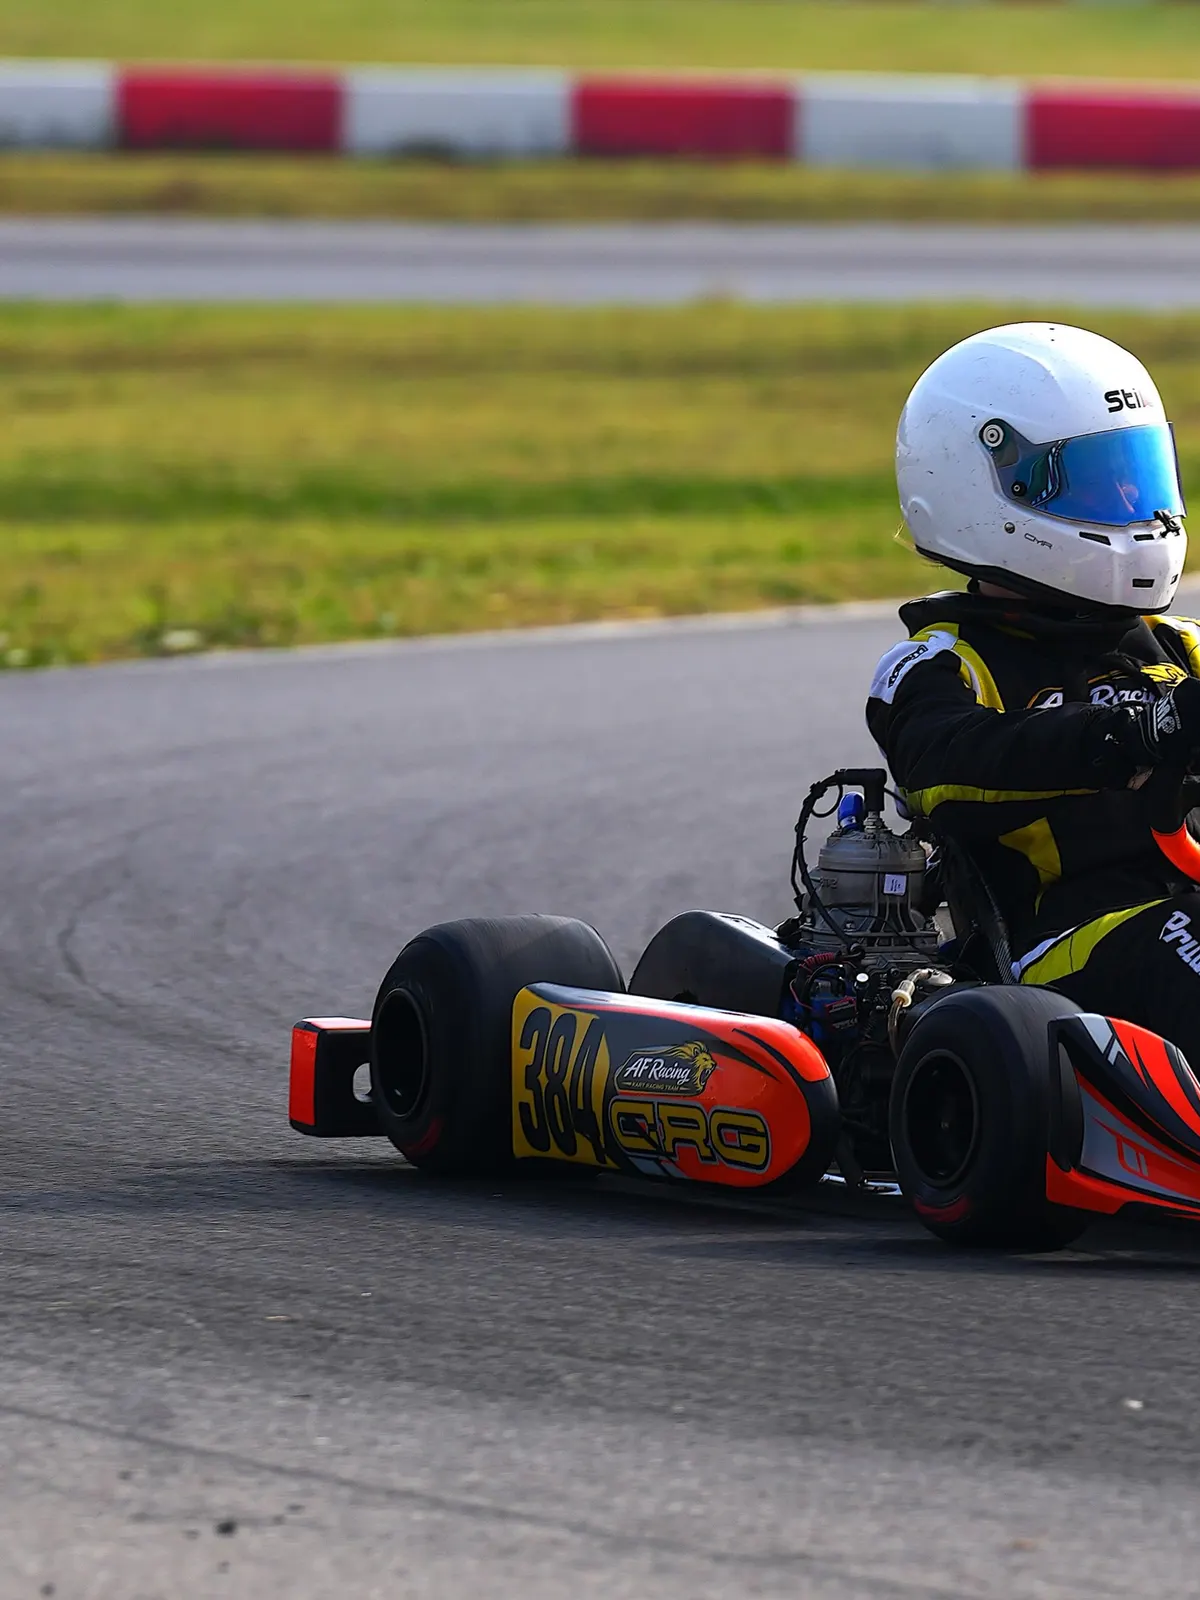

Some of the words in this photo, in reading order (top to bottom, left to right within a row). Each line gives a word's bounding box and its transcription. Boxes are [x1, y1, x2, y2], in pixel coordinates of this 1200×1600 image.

[1104, 388, 1153, 413] Stil
[519, 1006, 606, 1164] 384
[624, 1057, 653, 1078] AF
[648, 1058, 692, 1085] Racing
[610, 1097, 769, 1172] CRG
